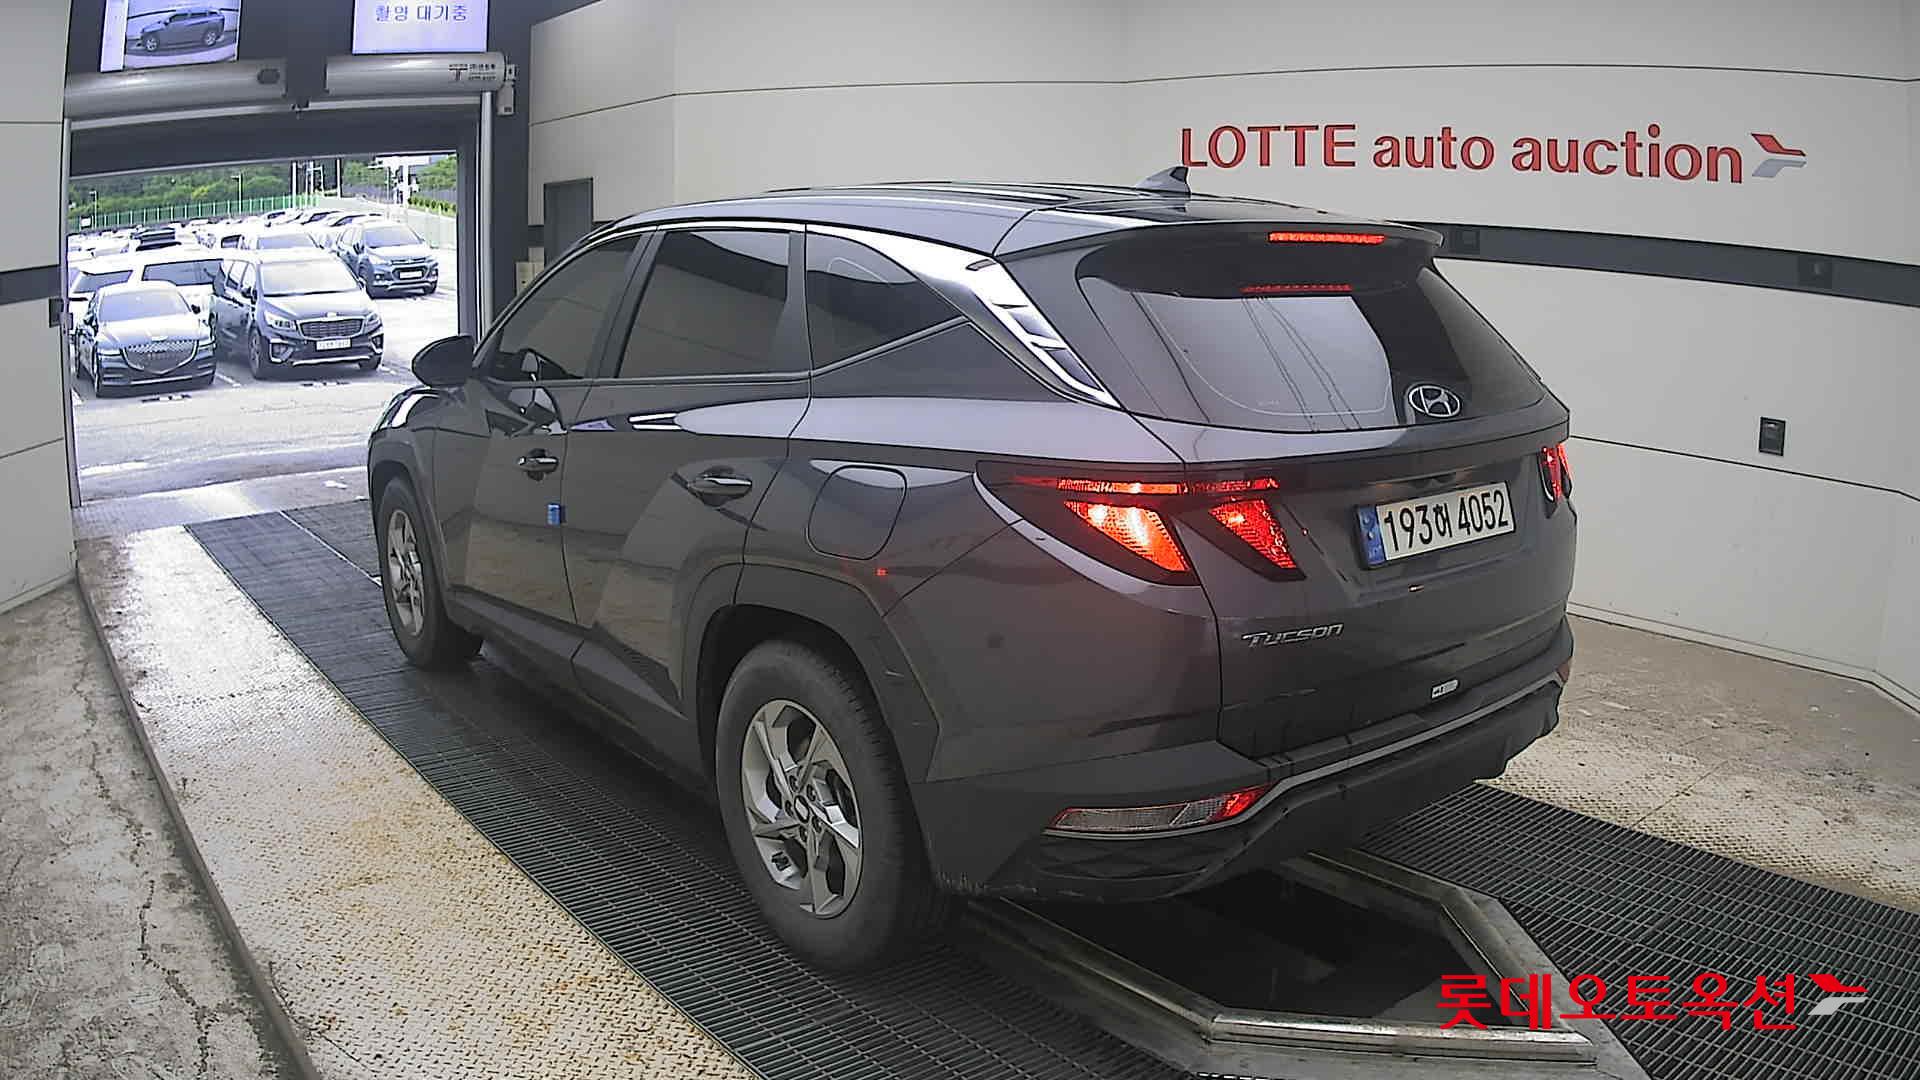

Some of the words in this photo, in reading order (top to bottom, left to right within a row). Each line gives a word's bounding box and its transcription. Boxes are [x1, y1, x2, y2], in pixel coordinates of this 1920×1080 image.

[417, 5, 467, 21] 대기중
[1182, 124, 1356, 168] LOTTE
[1373, 126, 1495, 170] auto
[1511, 124, 1742, 184] auction
[1458, 489, 1508, 535] 4052
